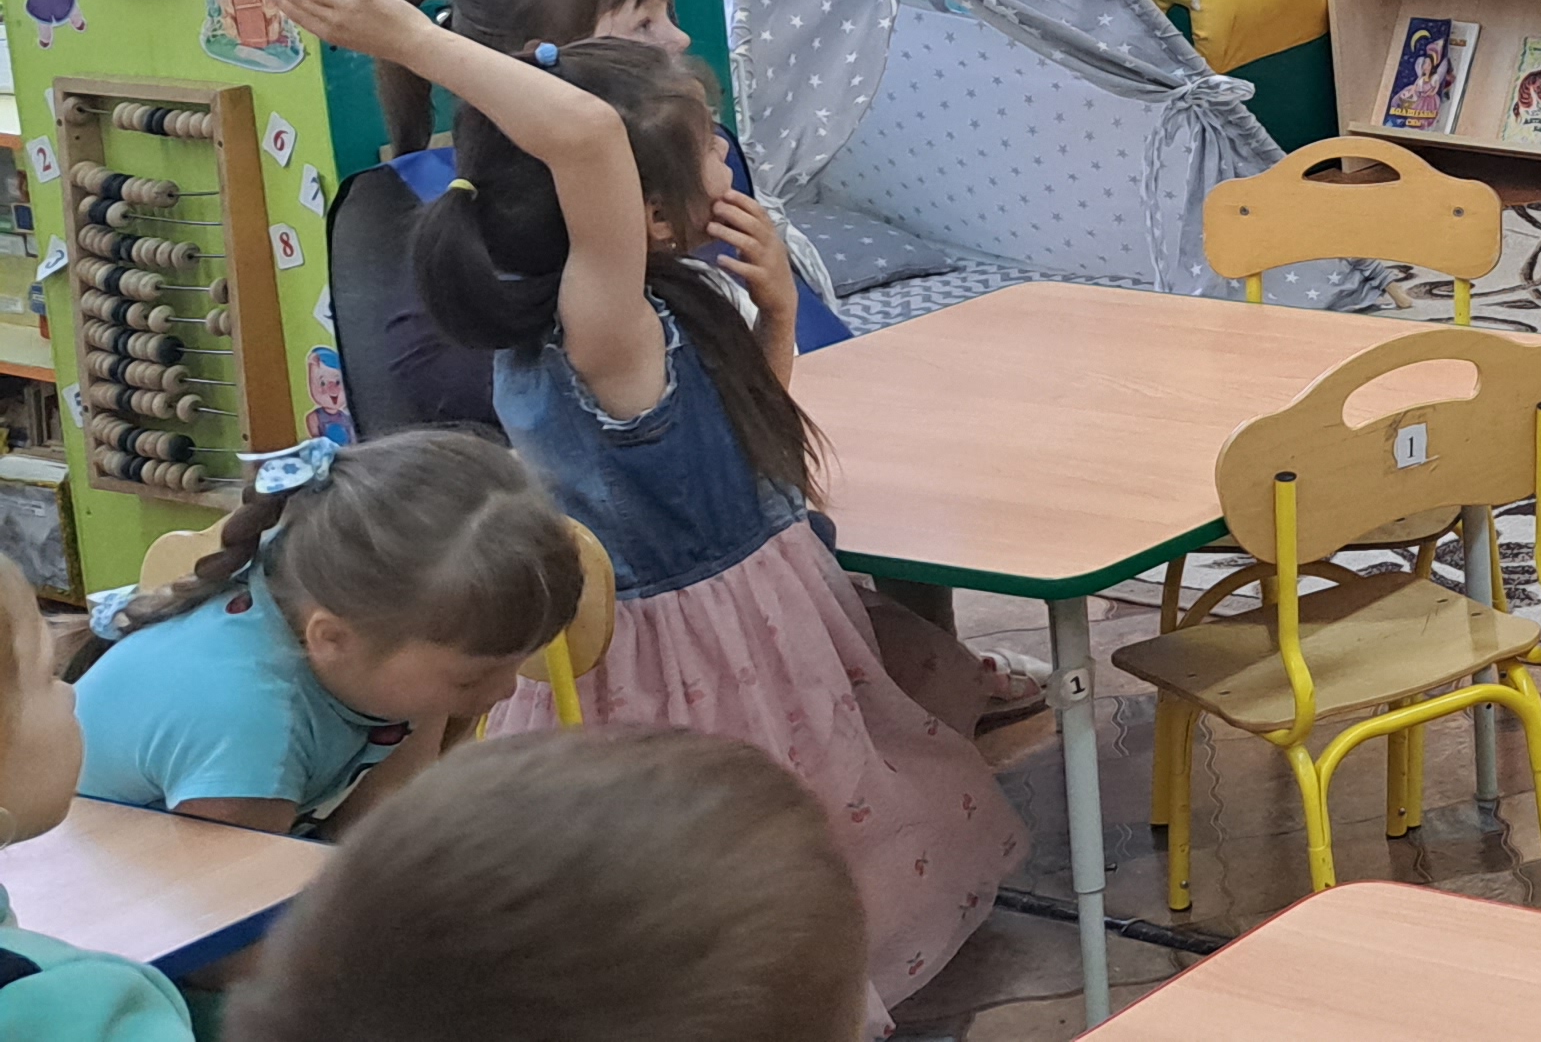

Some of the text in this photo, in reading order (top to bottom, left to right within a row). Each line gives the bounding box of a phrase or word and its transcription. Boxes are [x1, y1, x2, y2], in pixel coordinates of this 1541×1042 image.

[273, 130, 289, 151] 6
[36, 147, 52, 172] 2
[279, 231, 294, 258] 8
[1406, 438, 1416, 459] 1
[1070, 675, 1086, 695] 1
